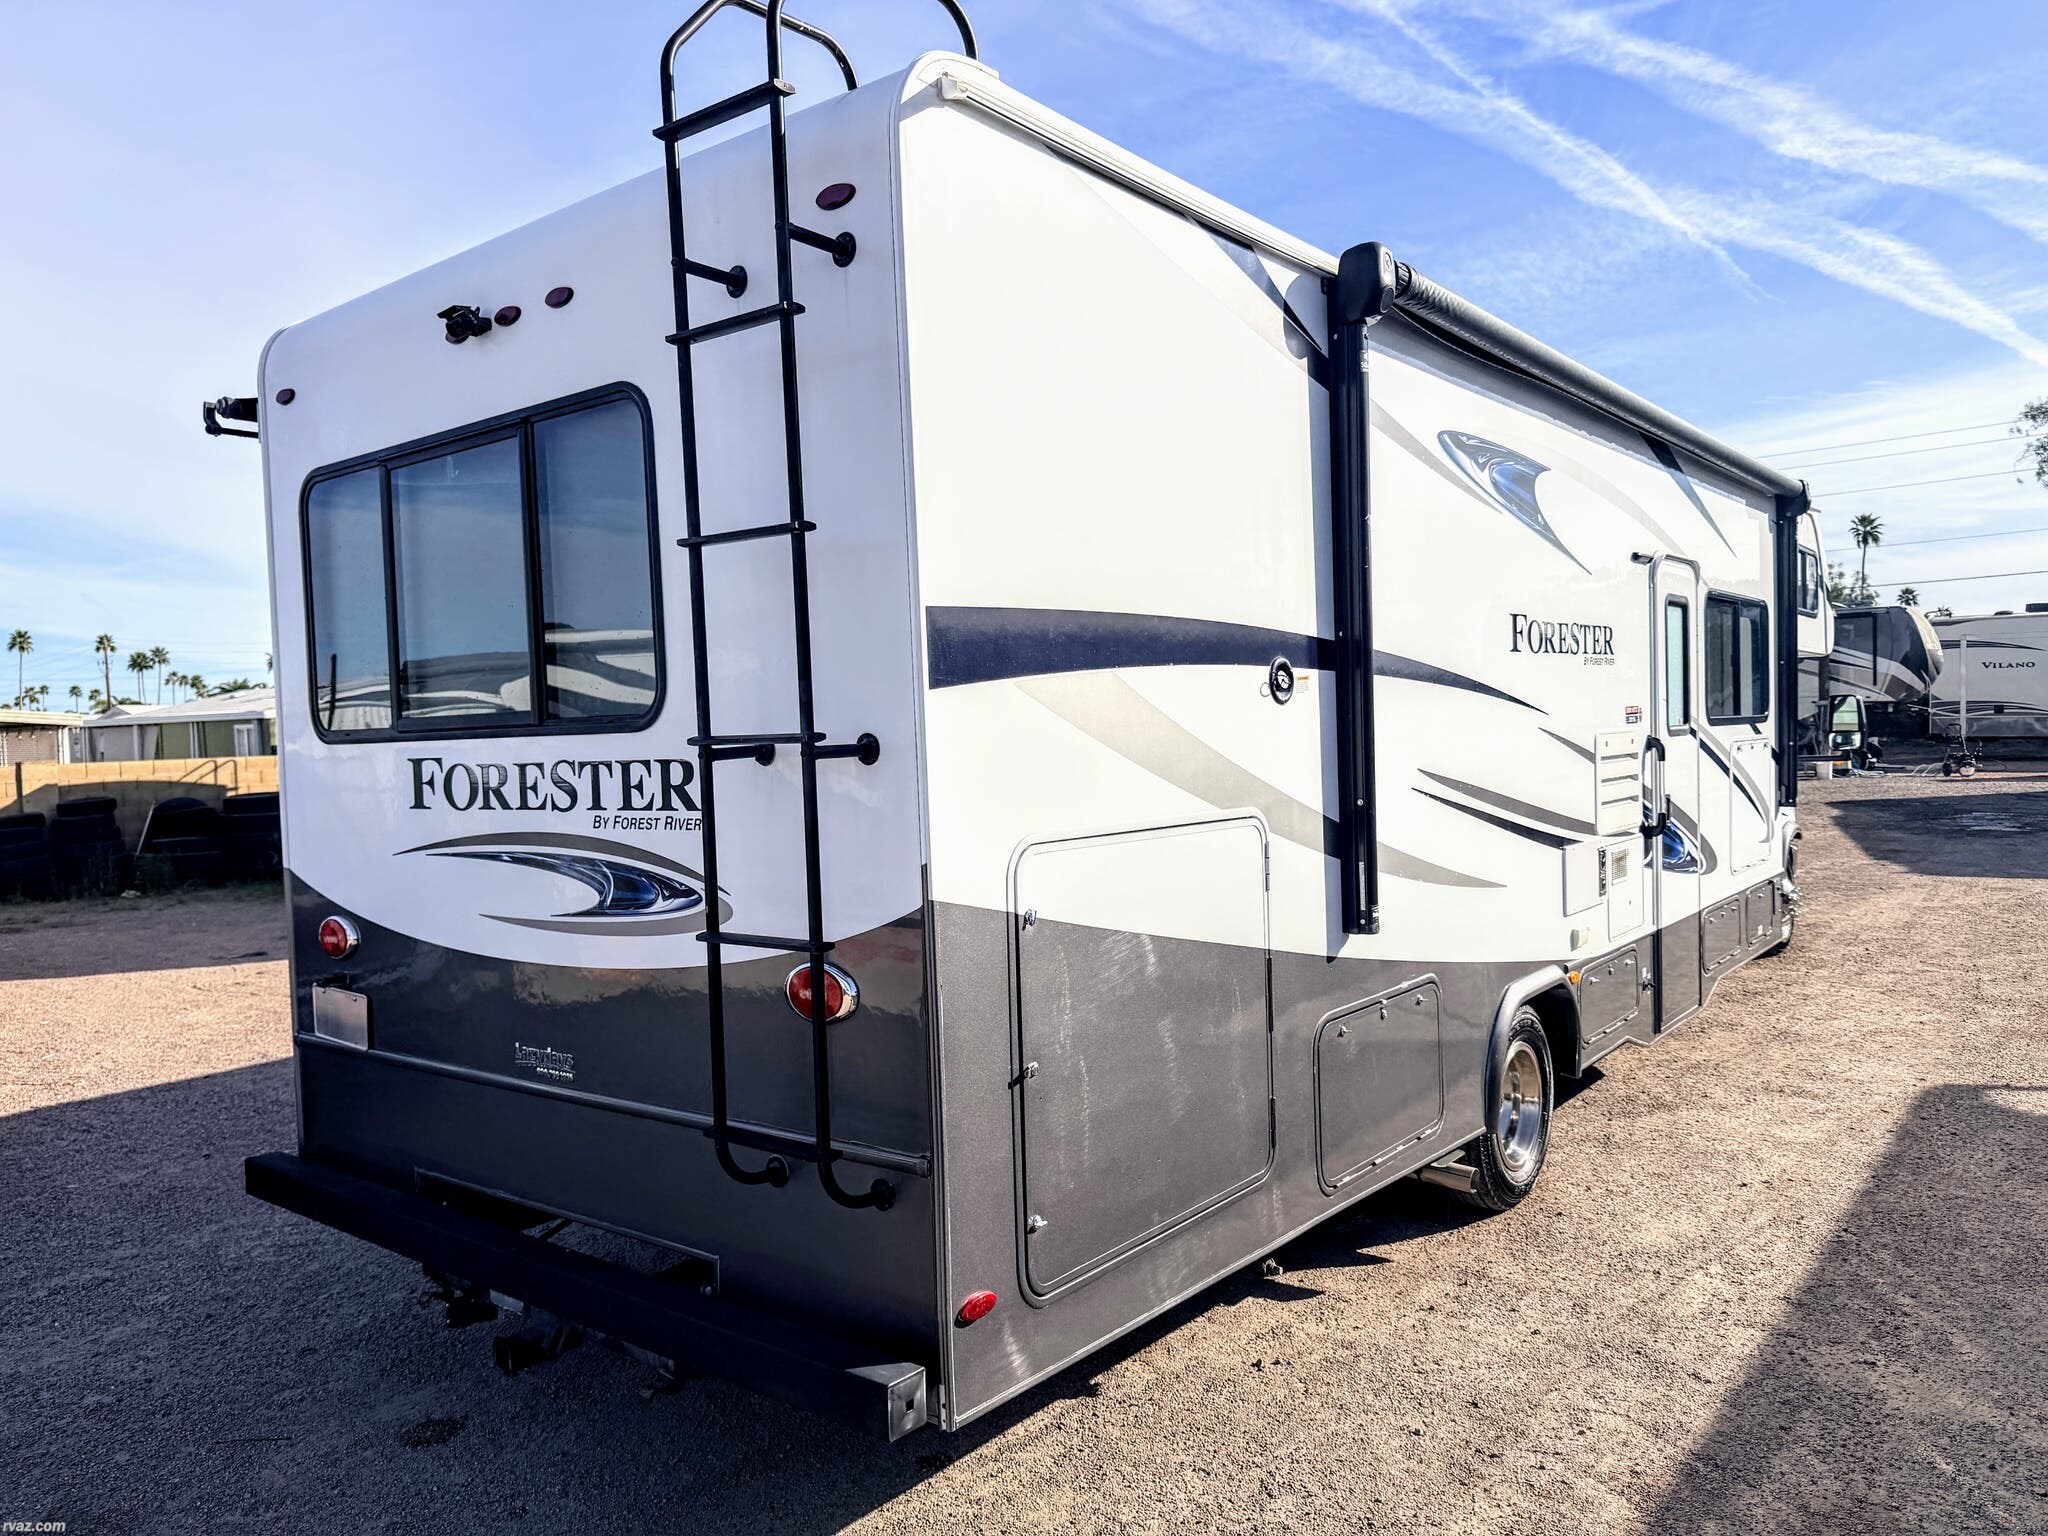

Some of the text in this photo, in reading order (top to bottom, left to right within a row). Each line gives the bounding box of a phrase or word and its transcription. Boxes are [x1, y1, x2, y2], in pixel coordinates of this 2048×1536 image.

[1509, 613, 1615, 655] FORESTER
[1981, 661, 2036, 669] VILANO
[407, 757, 702, 813] FORESTER
[593, 815, 703, 832] BY FOREST RIVER
